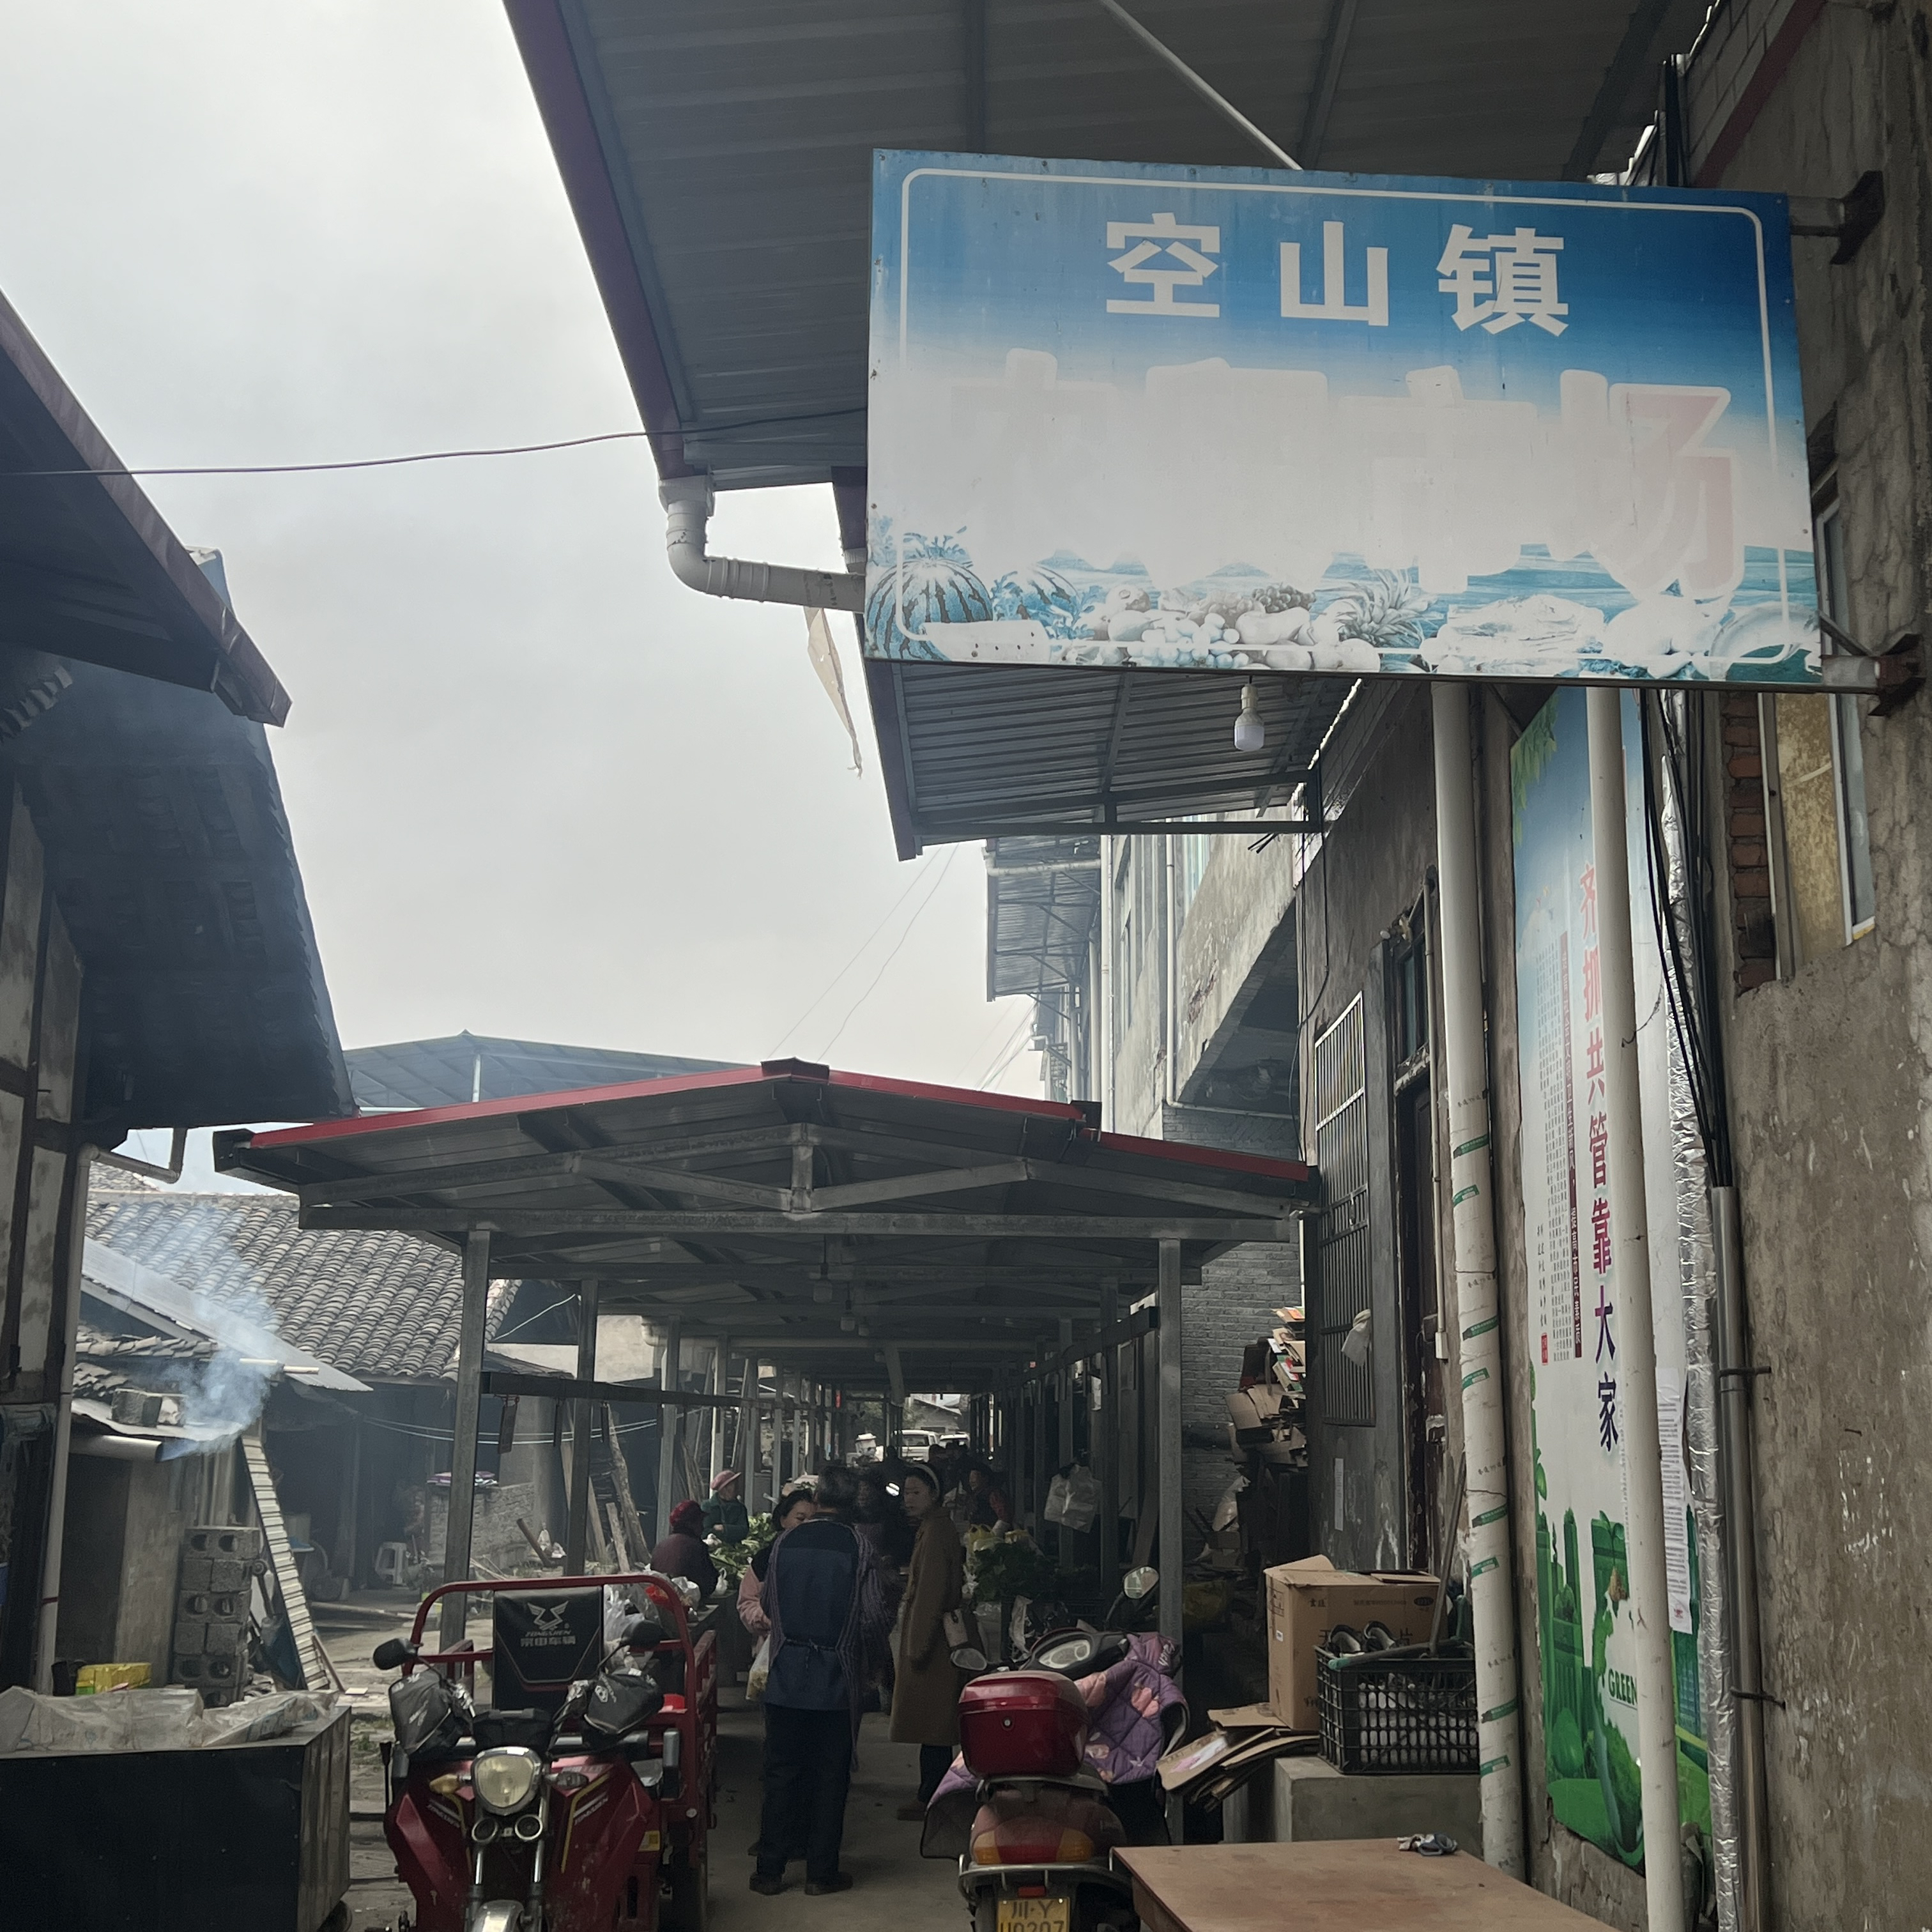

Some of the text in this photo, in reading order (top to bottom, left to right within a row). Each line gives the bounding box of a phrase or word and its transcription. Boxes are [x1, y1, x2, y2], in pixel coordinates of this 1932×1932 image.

[1105, 212, 1568, 337] 空山镇
[1580, 864, 1618, 1452] 齐抓共管靠大家
[1608, 1668, 1637, 1705] GREEN
